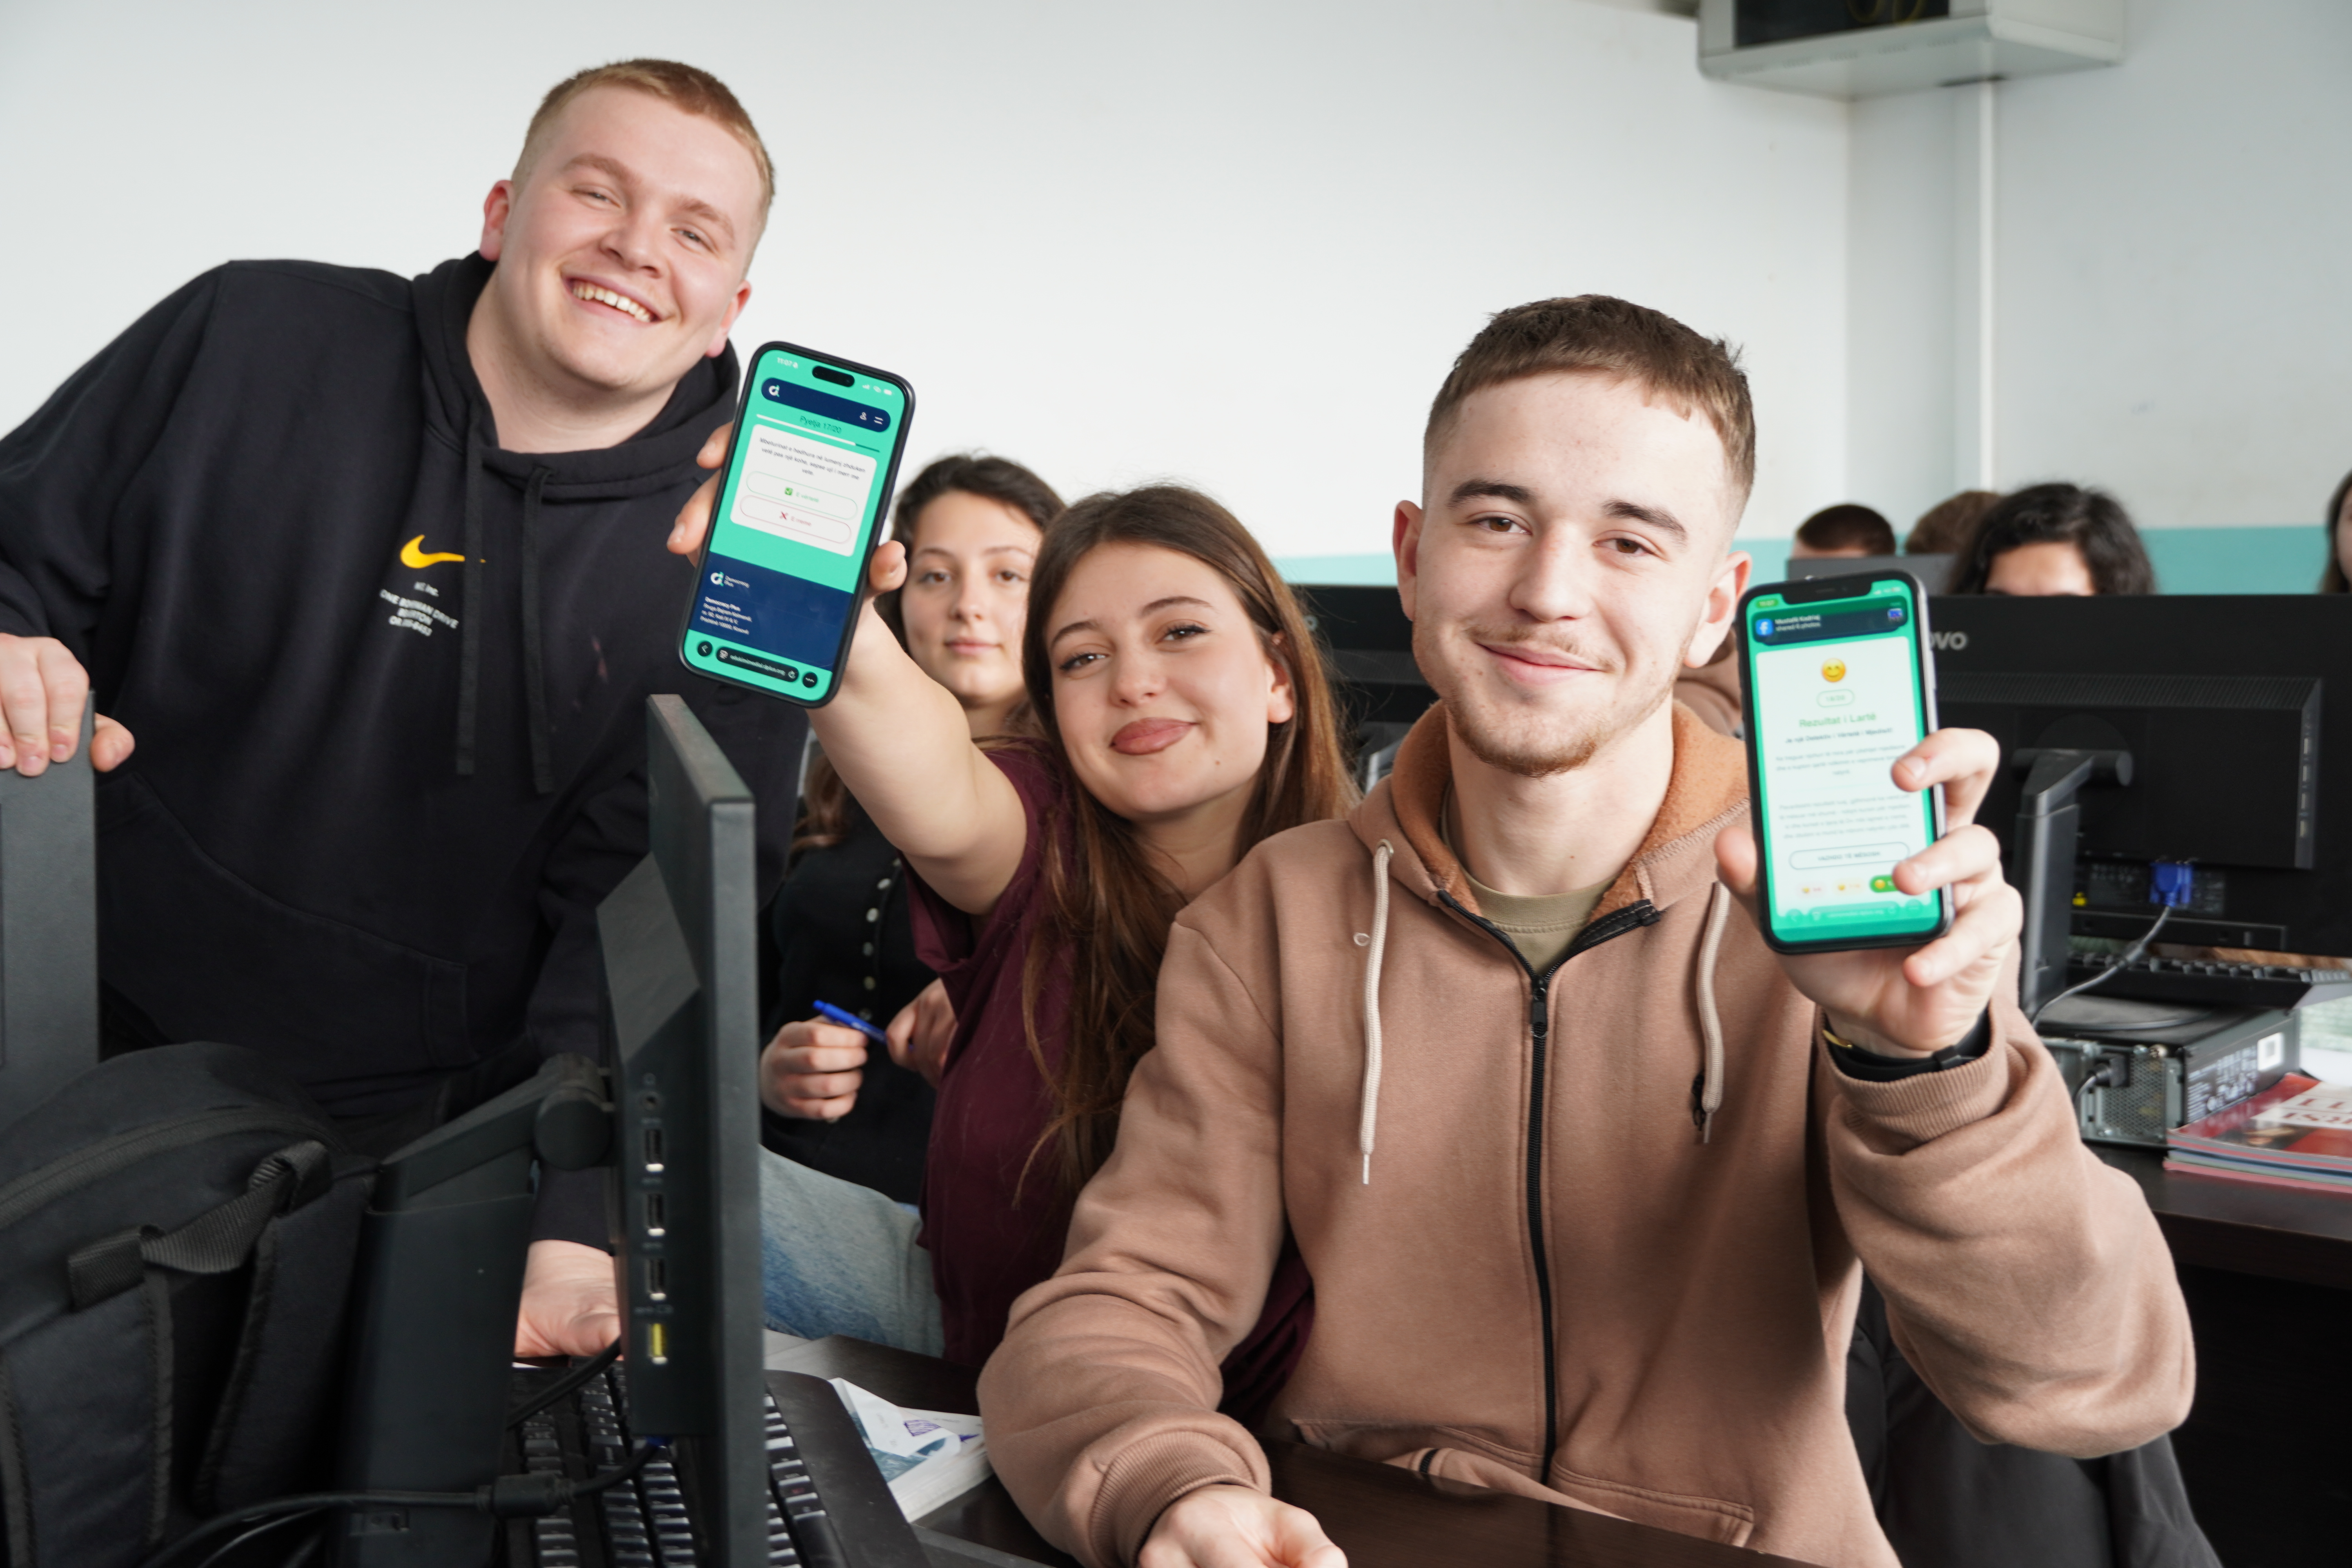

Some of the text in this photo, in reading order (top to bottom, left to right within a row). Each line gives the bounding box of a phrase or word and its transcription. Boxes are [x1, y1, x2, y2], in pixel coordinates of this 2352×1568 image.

[800, 416, 841, 434] Pyetja 17/20
[810, 462, 824, 470] sepse
[1798, 715, 1840, 728] Rezultat
